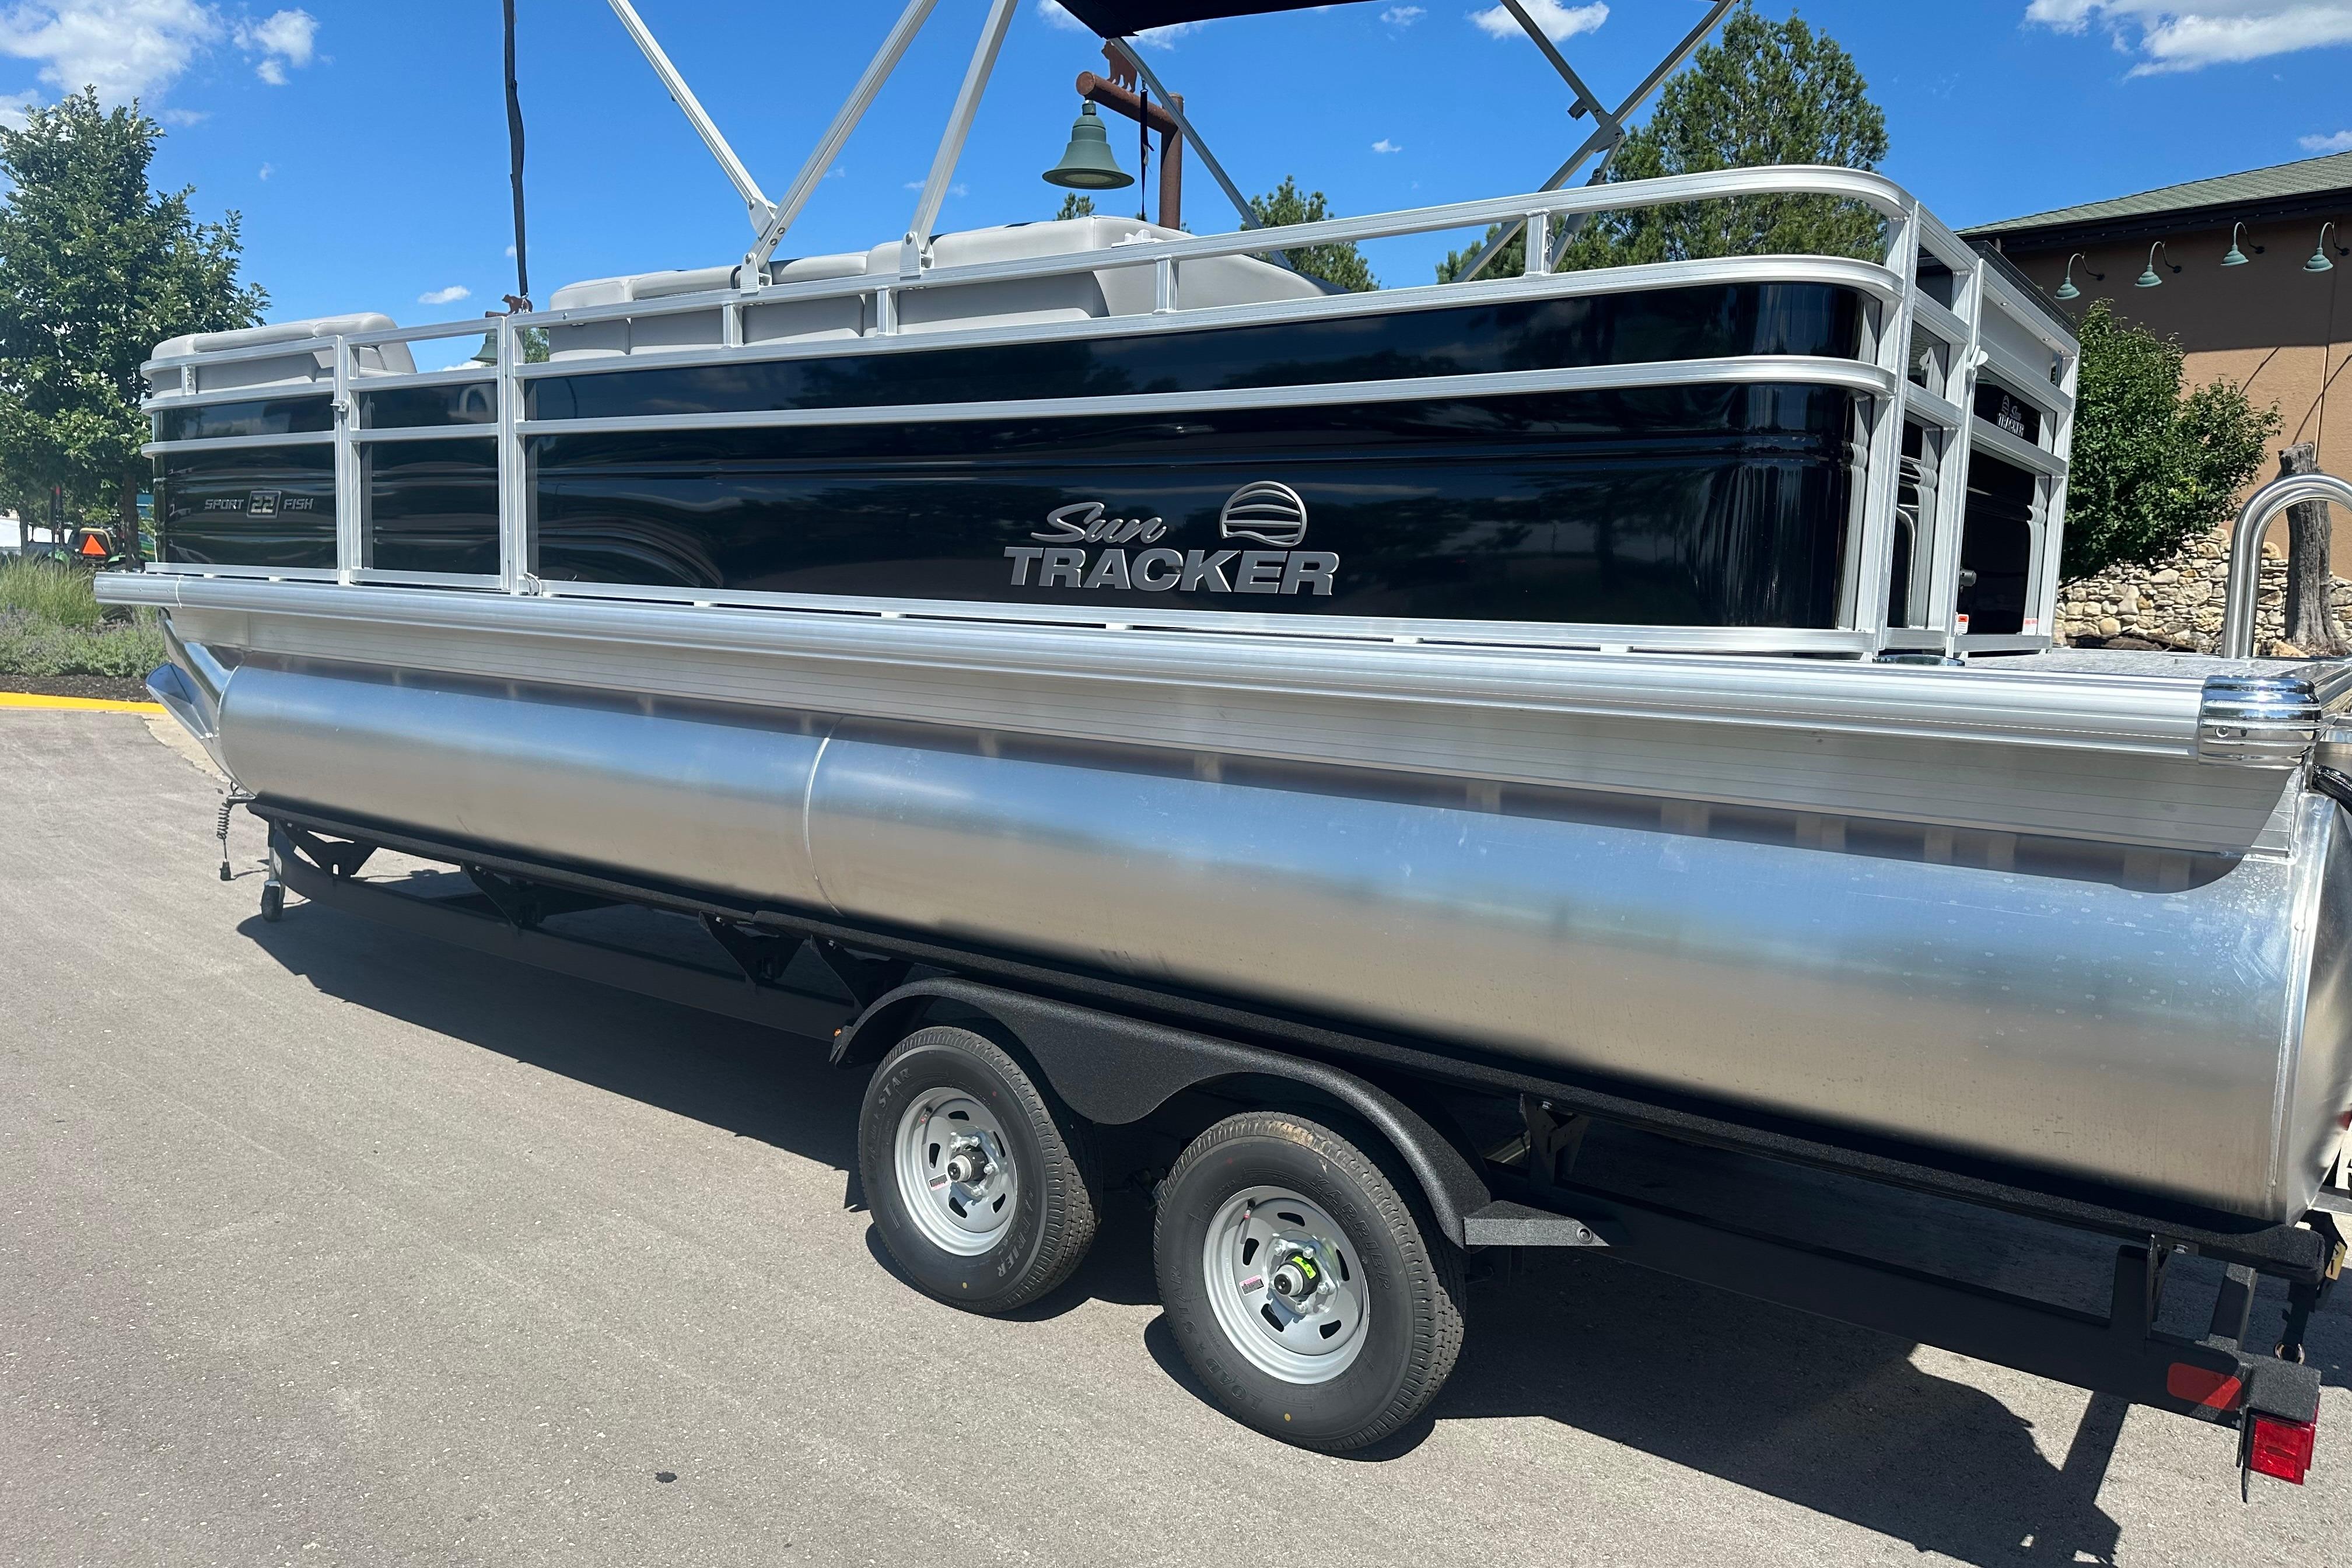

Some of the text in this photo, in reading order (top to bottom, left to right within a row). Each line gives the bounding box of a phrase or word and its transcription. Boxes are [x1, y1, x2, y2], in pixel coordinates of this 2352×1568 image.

[204, 496, 314, 513] SPORT 22 FISH
[1030, 501, 1167, 544] Sun
[1003, 546, 1340, 596] TRACKER
[878, 1067, 912, 1108] STAR
[1311, 1173, 1391, 1290] KARRIER
[1170, 1265, 1196, 1334] STAR
[1206, 1358, 1262, 1410] LOAD
